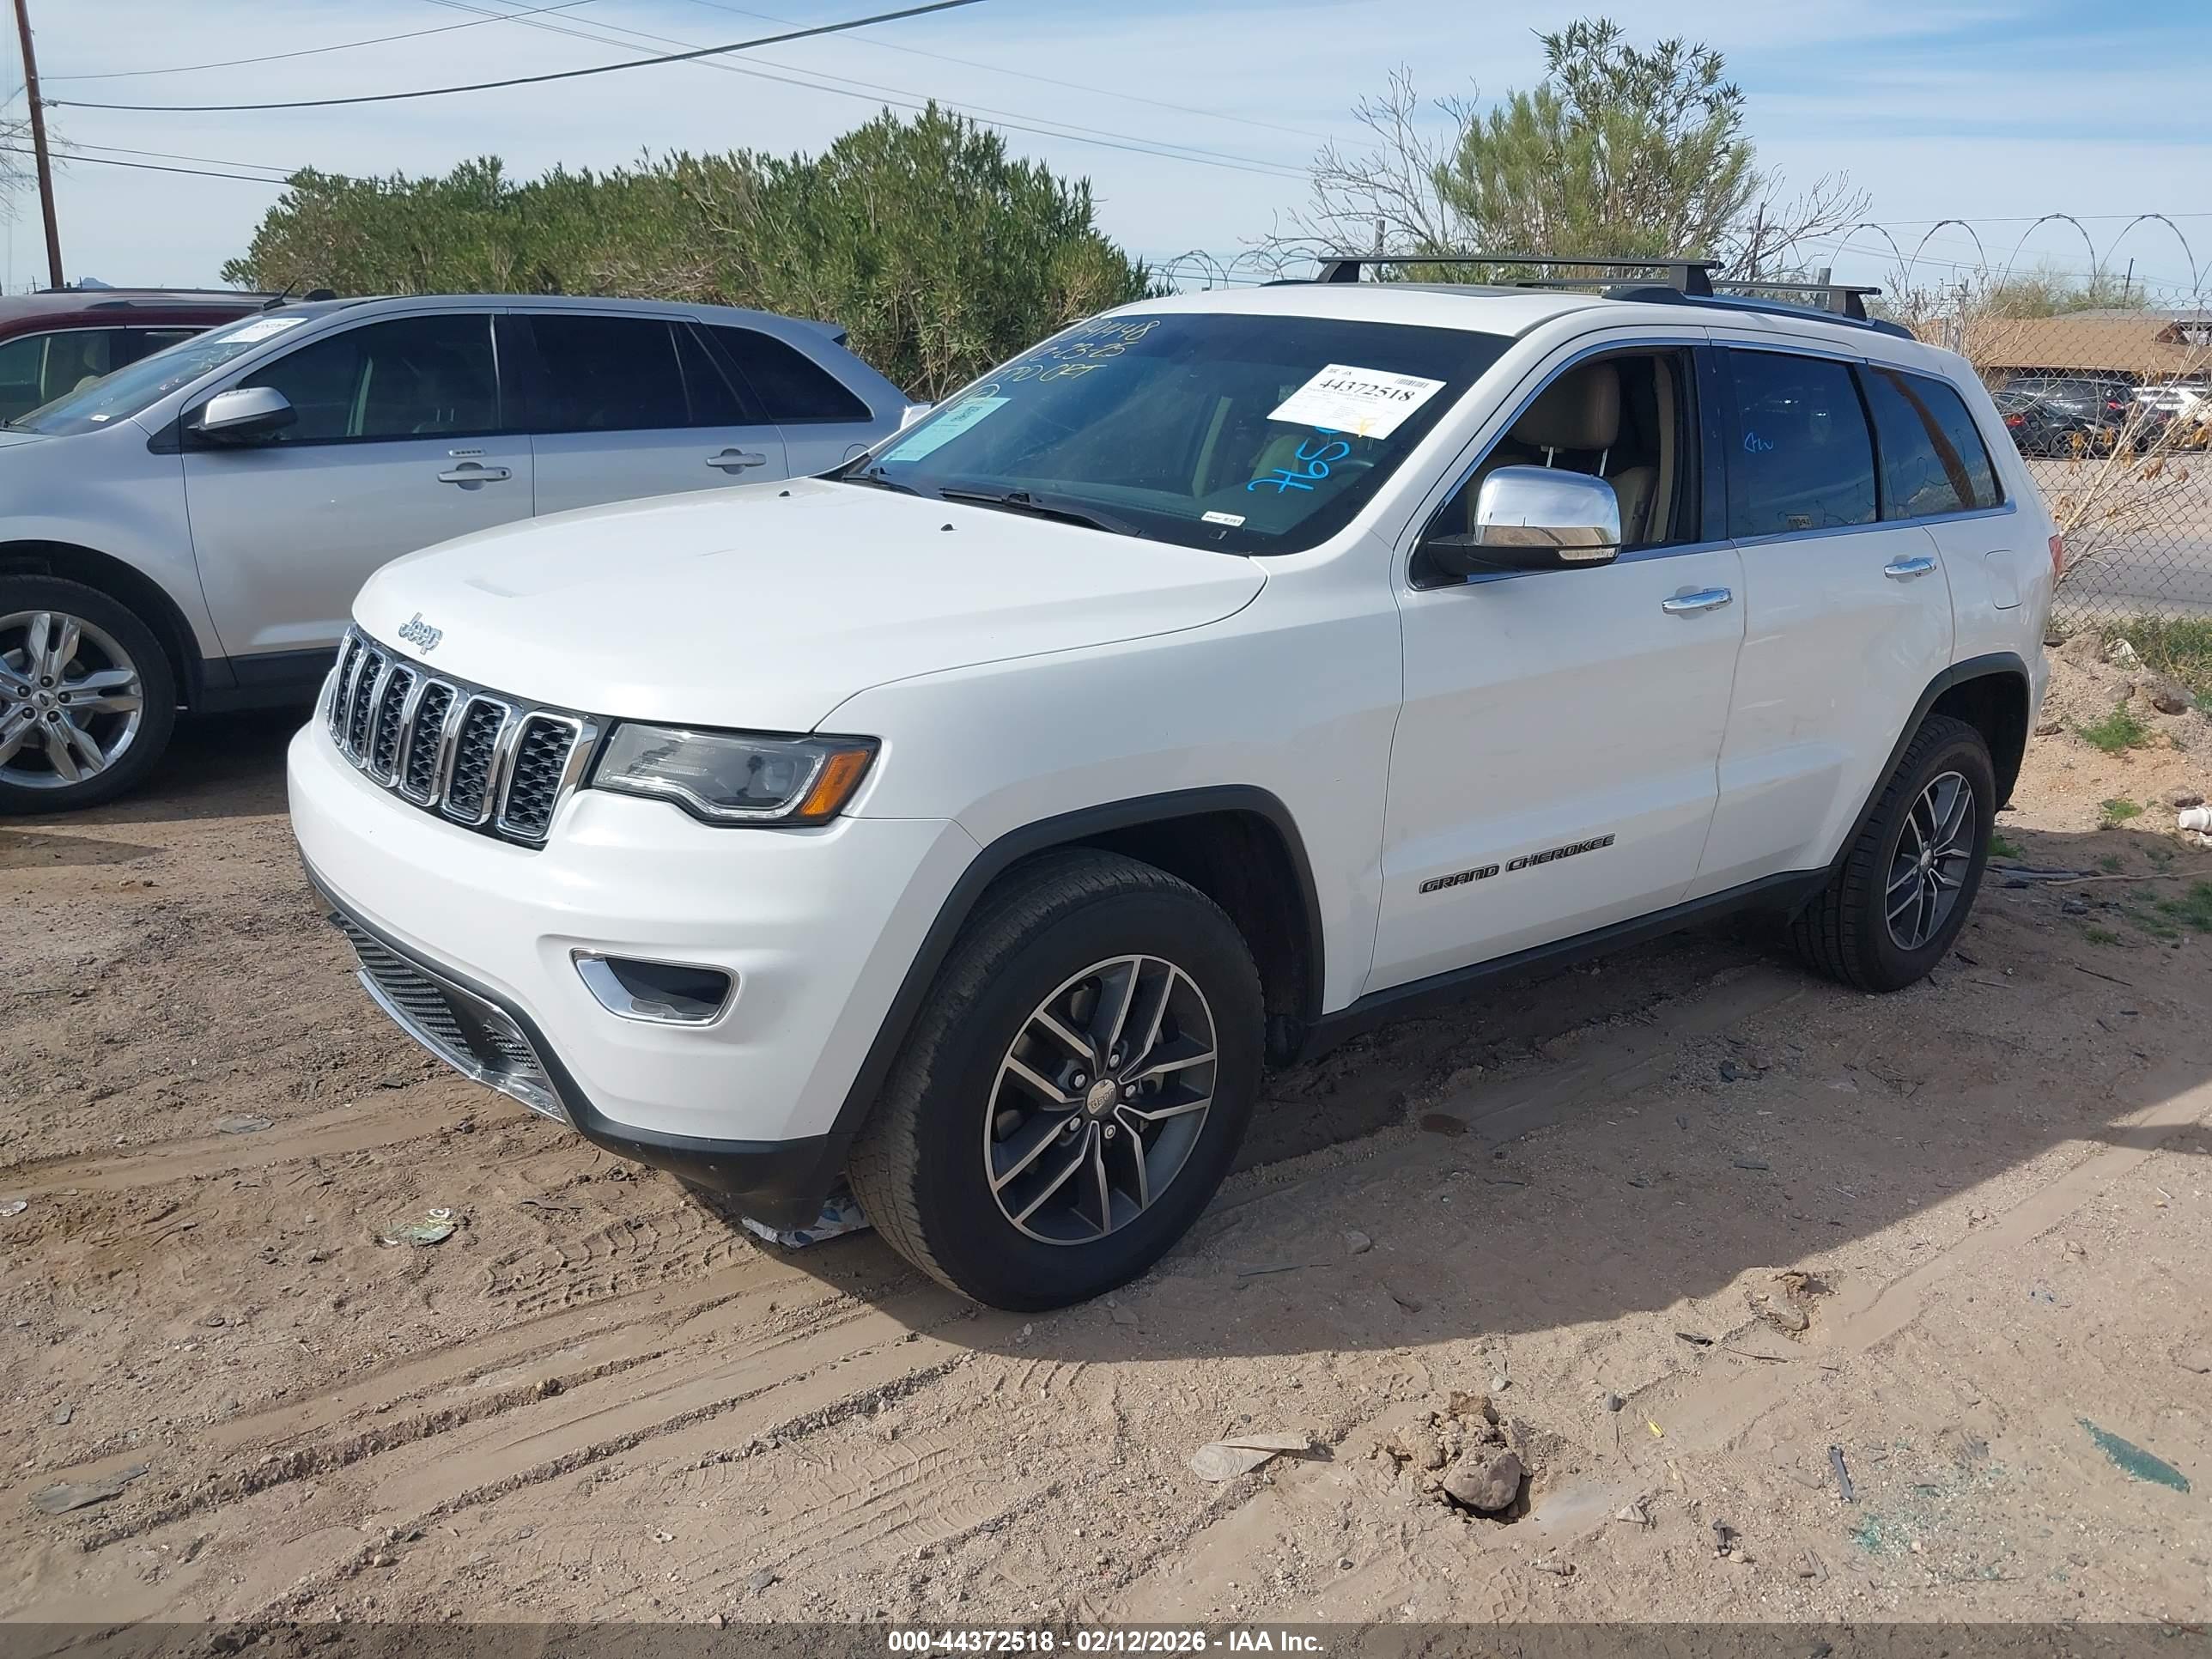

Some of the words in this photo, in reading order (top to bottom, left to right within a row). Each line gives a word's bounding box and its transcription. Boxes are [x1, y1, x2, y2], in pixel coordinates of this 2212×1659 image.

[1319, 378, 1416, 402] 44372518
[398, 611, 443, 656] Jeep
[1418, 862, 1501, 895] GRAND
[1504, 832, 1616, 872] CHEROKEE
